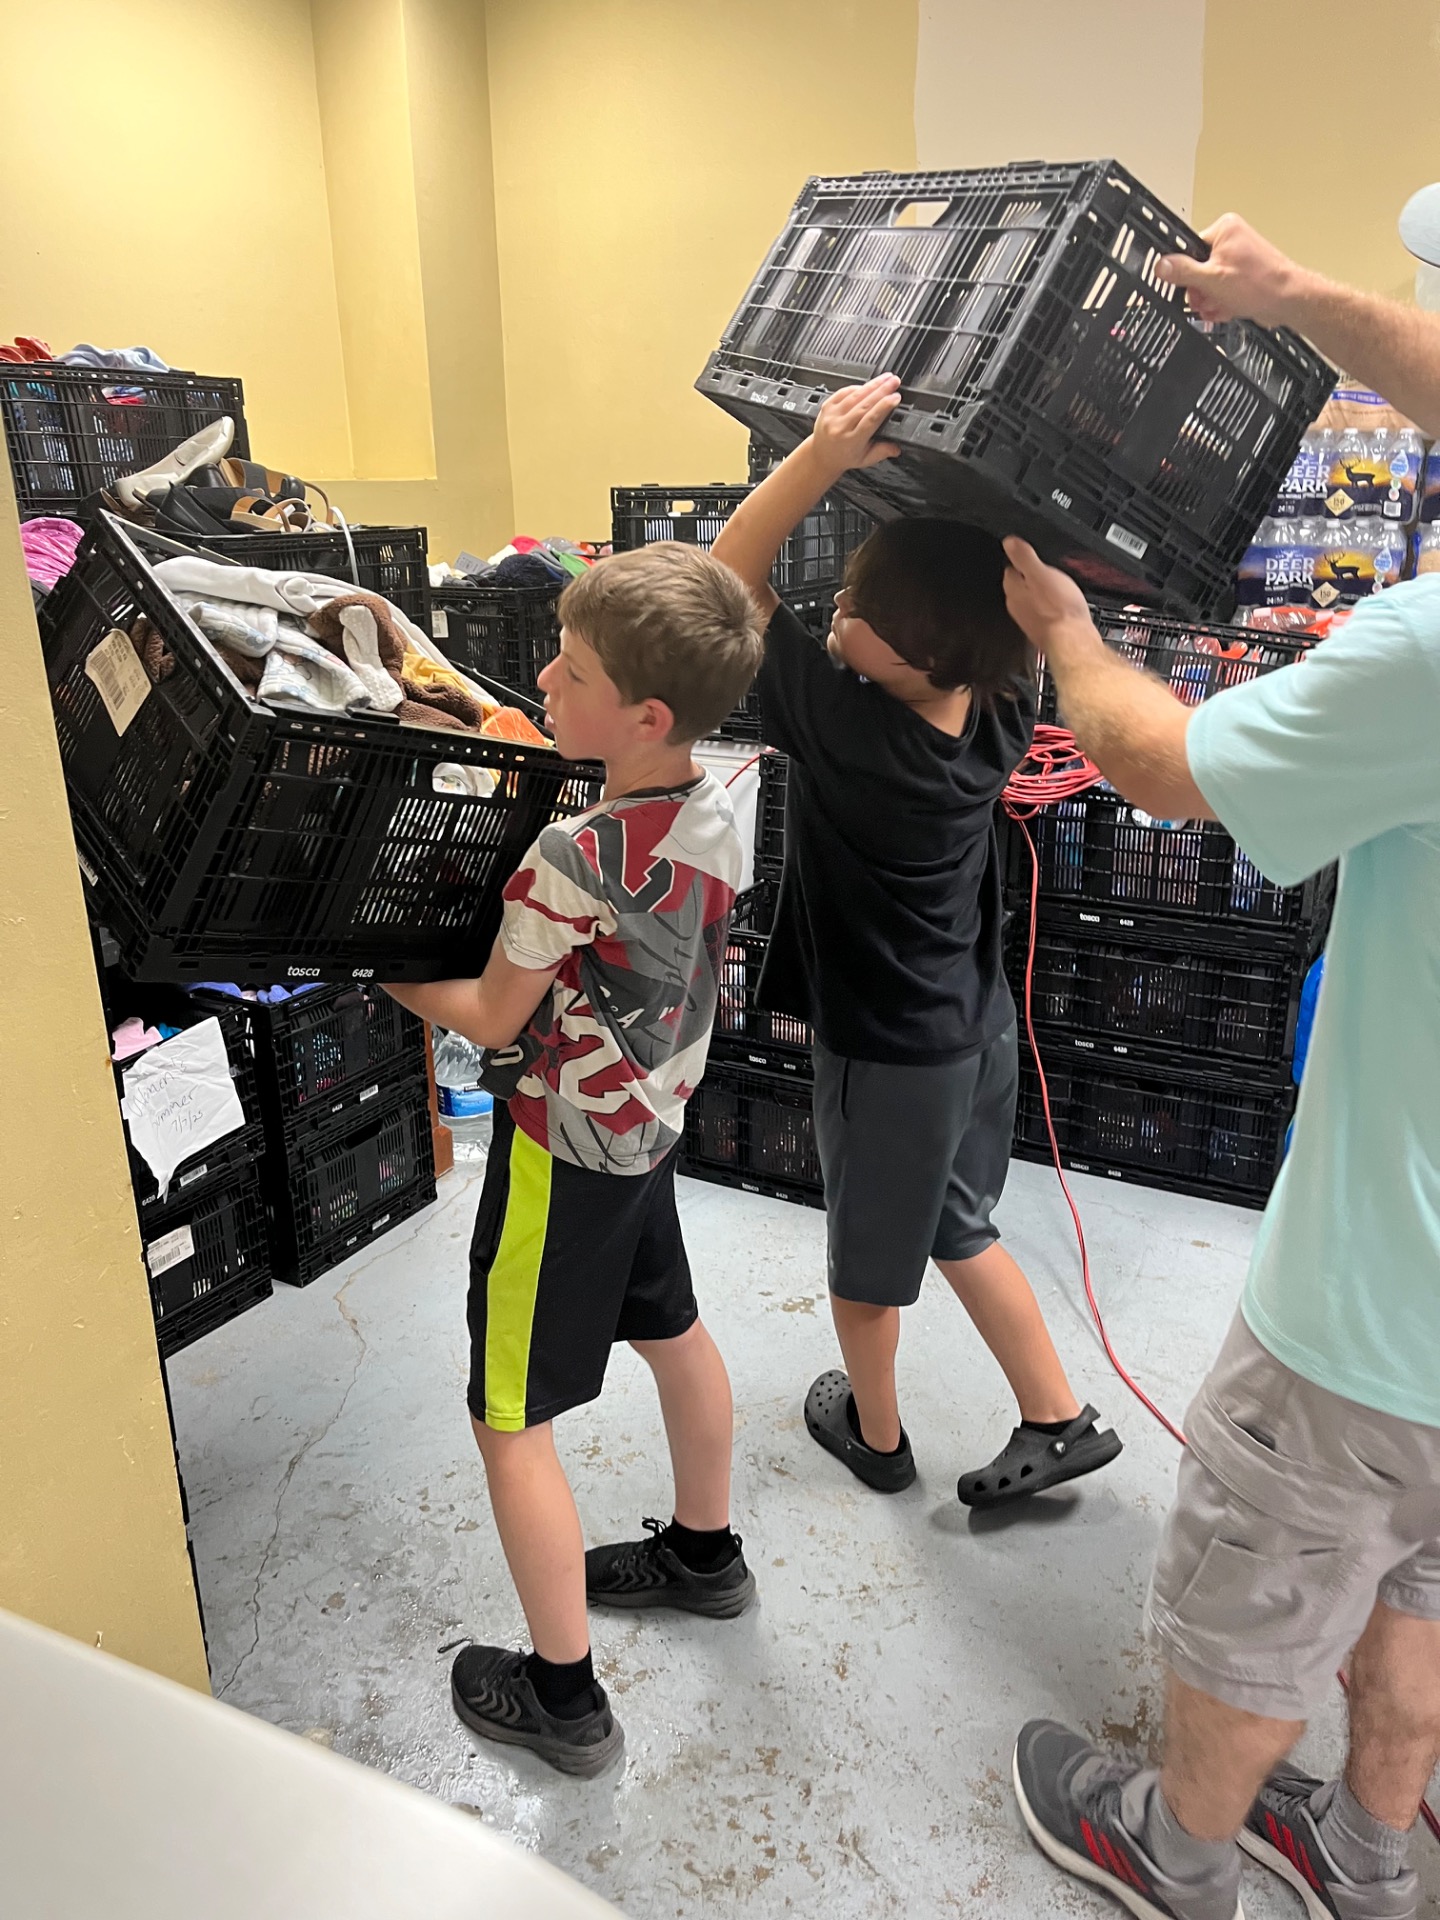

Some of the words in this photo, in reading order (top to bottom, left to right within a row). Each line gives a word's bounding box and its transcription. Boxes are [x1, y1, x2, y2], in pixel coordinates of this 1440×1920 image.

[1265, 557, 1315, 572] DEER
[1265, 570, 1314, 588] PARK
[1079, 912, 1100, 922] tosca
[287, 965, 320, 976] tosca
[352, 968, 374, 977] 6428
[1074, 1039, 1094, 1049] tosca
